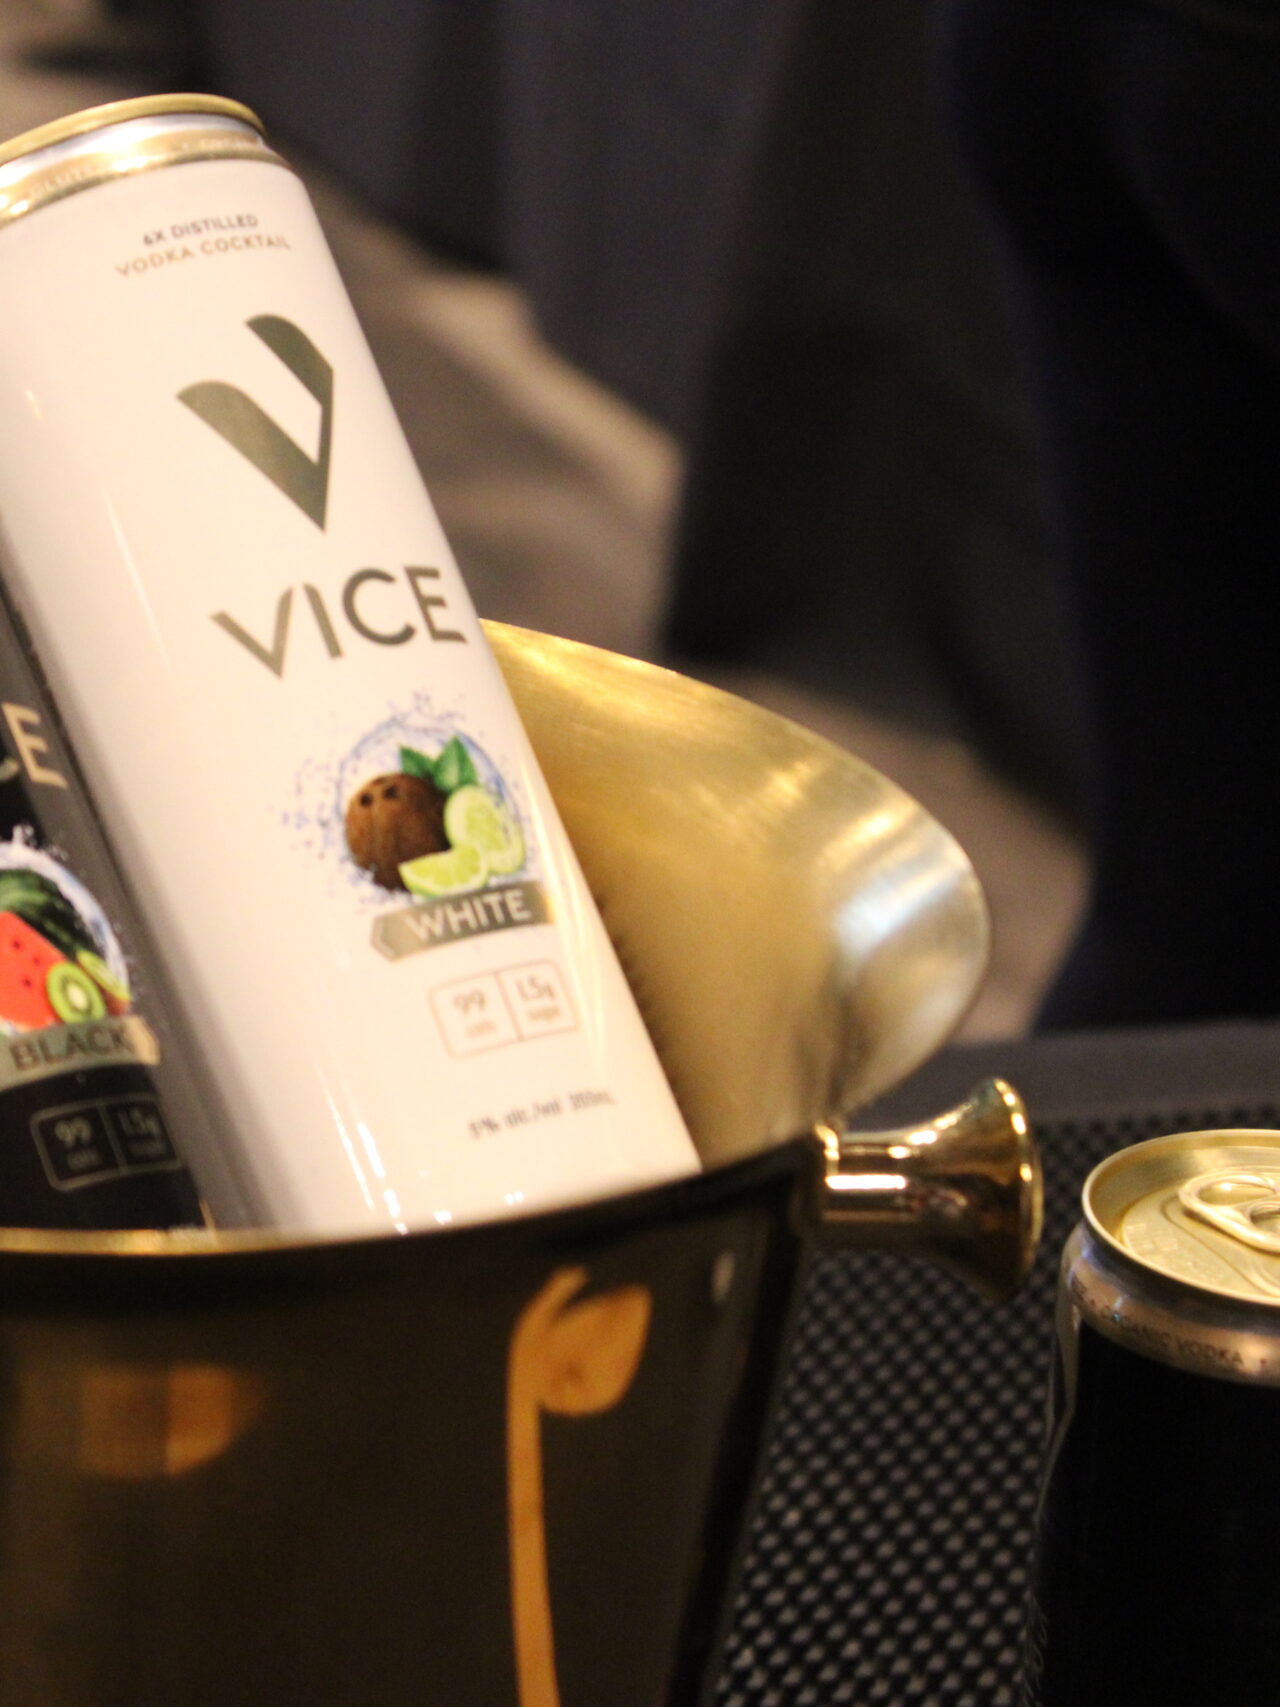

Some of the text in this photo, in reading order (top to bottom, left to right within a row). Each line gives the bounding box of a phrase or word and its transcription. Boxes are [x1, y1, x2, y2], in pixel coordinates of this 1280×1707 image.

[170, 214, 258, 239] DISTILLED
[115, 234, 291, 277] VODKA COCKTAIL
[210, 566, 468, 679] VICE
[405, 889, 532, 942] WHITE
[10, 1022, 134, 1072] BLACK
